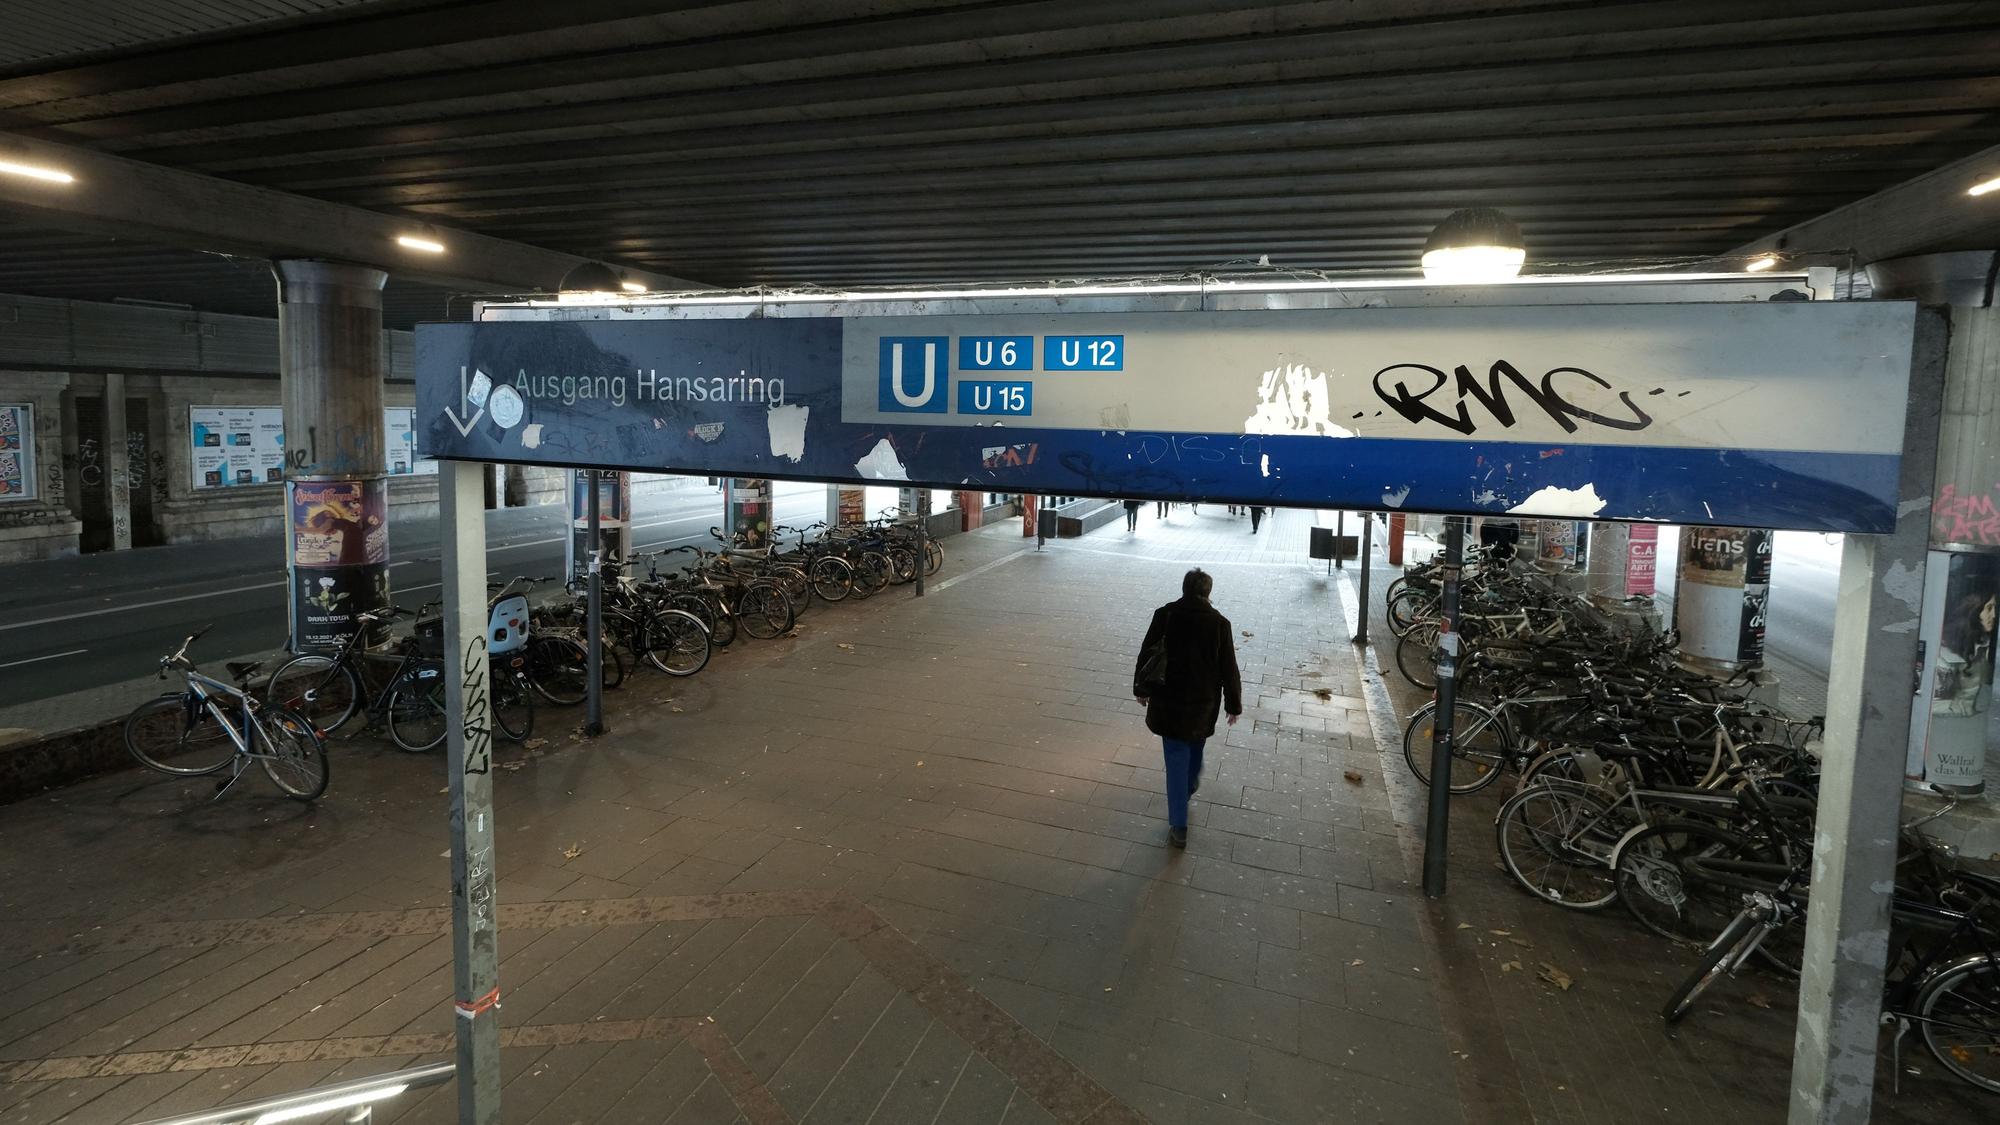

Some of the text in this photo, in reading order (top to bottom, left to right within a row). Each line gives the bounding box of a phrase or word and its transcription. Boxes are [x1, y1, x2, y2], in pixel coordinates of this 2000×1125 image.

[975, 341, 1016, 366] U 6
[1061, 340, 1117, 365] U 12
[515, 368, 786, 406] Ausgang Hansaring
[891, 343, 937, 407] U
[974, 386, 1025, 411] U 15
